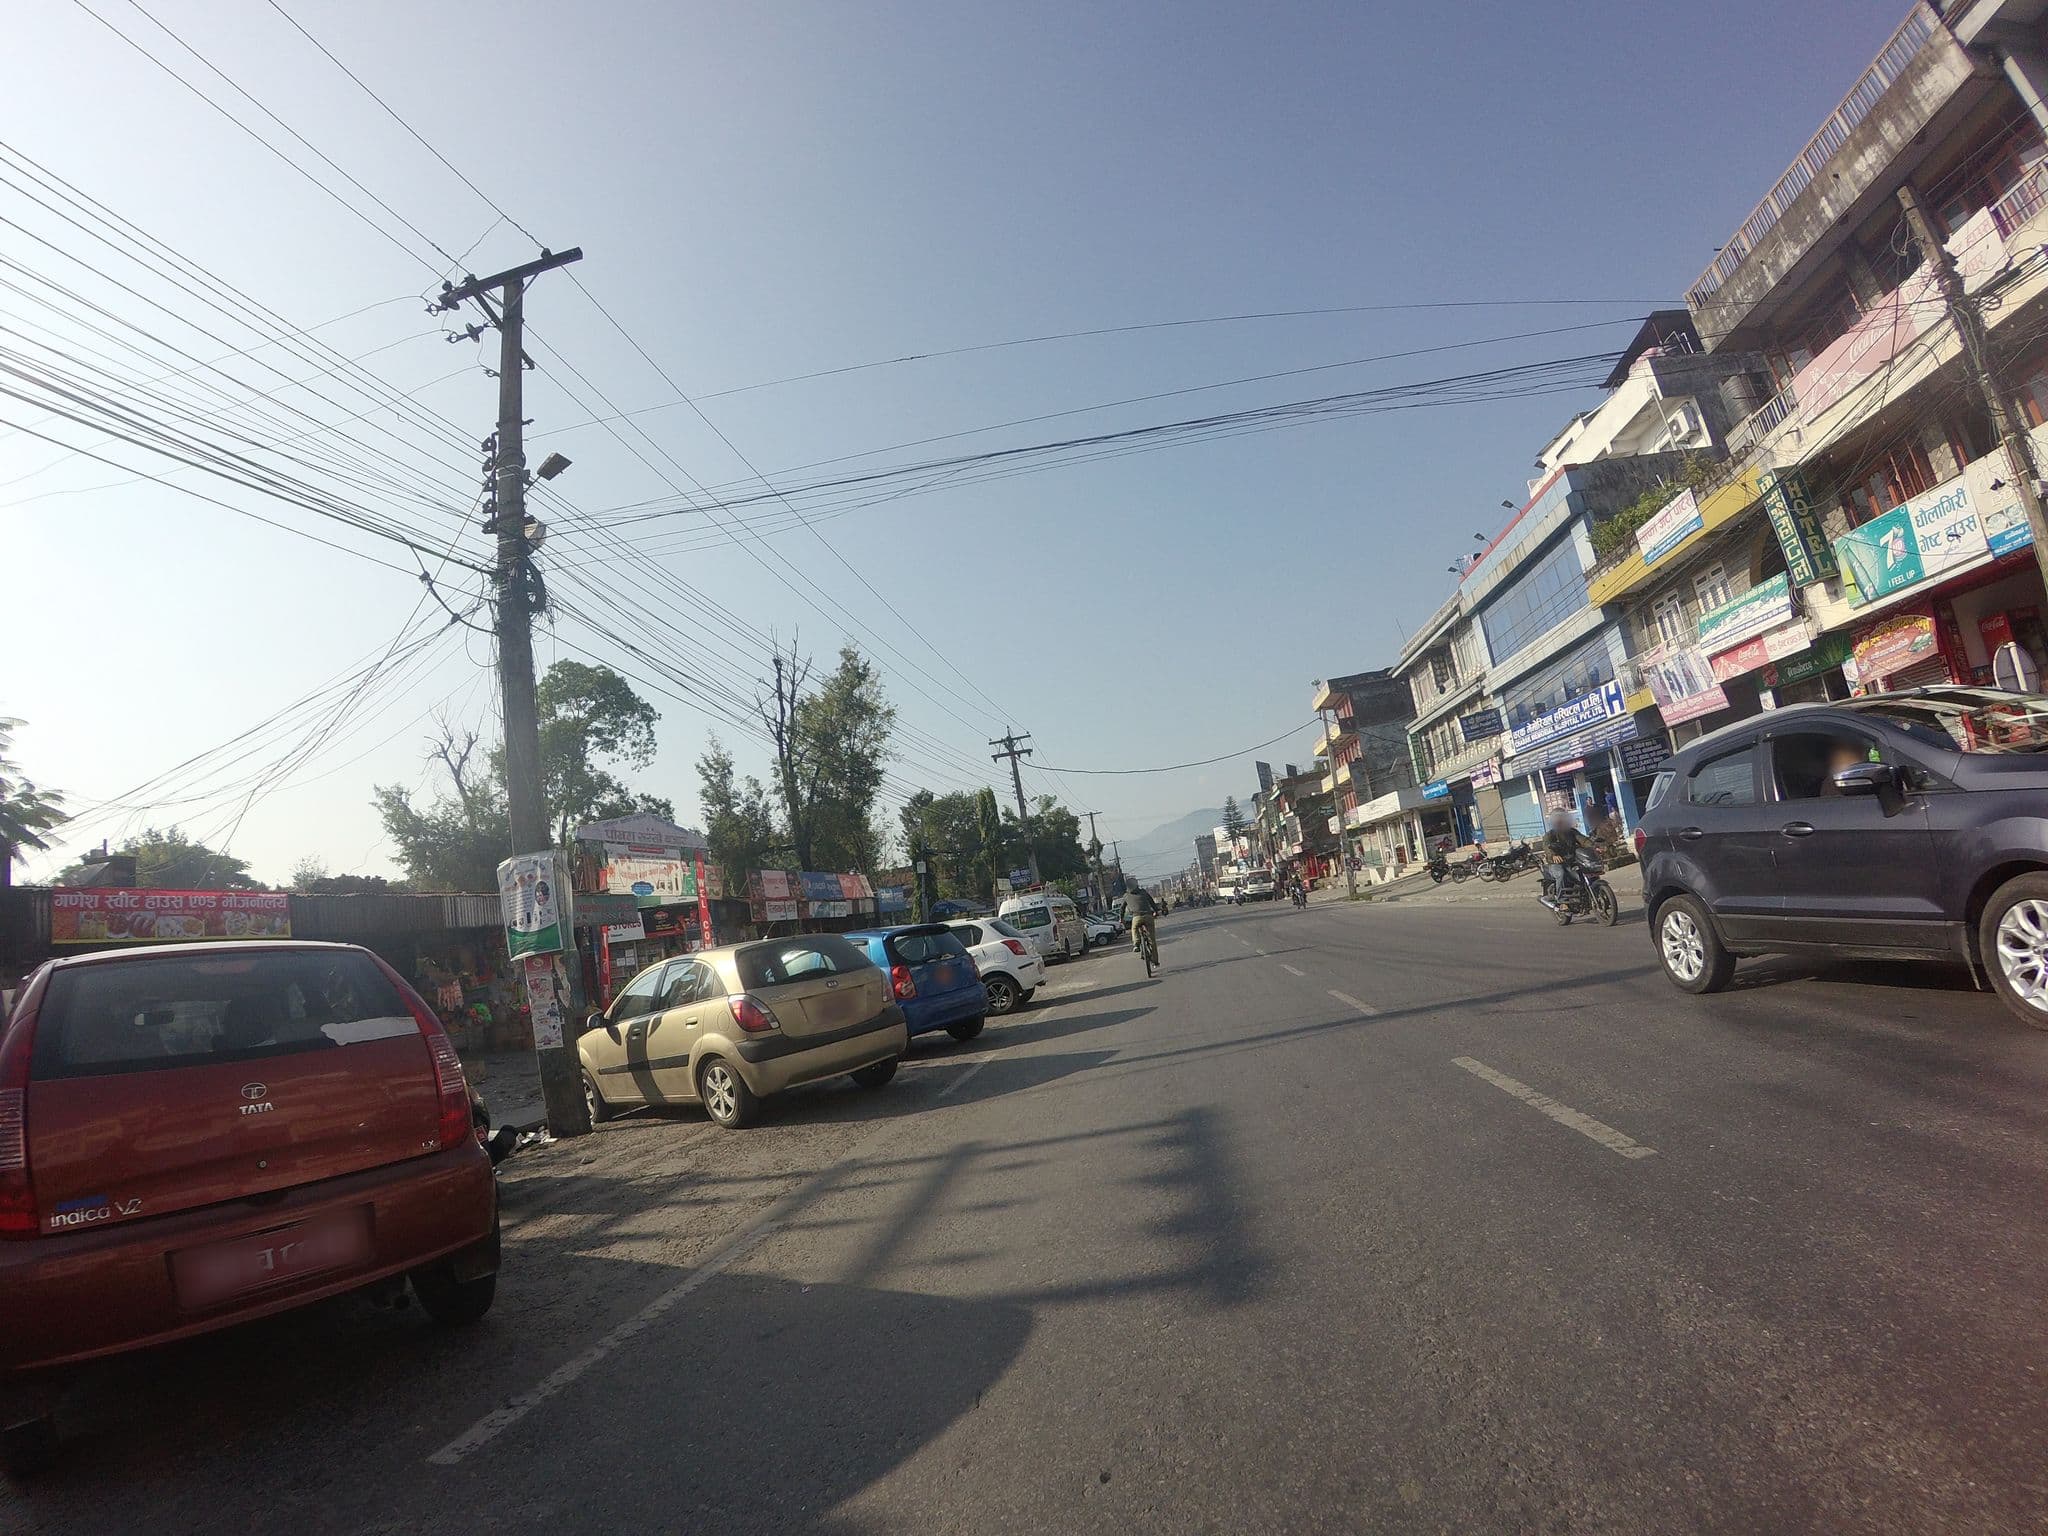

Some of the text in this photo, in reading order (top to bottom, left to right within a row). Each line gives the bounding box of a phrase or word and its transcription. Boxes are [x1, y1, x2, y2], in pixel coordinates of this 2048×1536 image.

[1785, 480, 1838, 575] HOTEL
[1891, 574, 1906, 587] FEEL
[1906, 569, 1916, 580] UP
[1604, 681, 1625, 715] H
[1555, 717, 1580, 731] HOSPITAL
[54, 891, 288, 909] गणेश स्वीट हाउस एण्ड भोजनालय
[239, 1101, 274, 1115] TATA
[51, 1198, 143, 1228] indica V2
